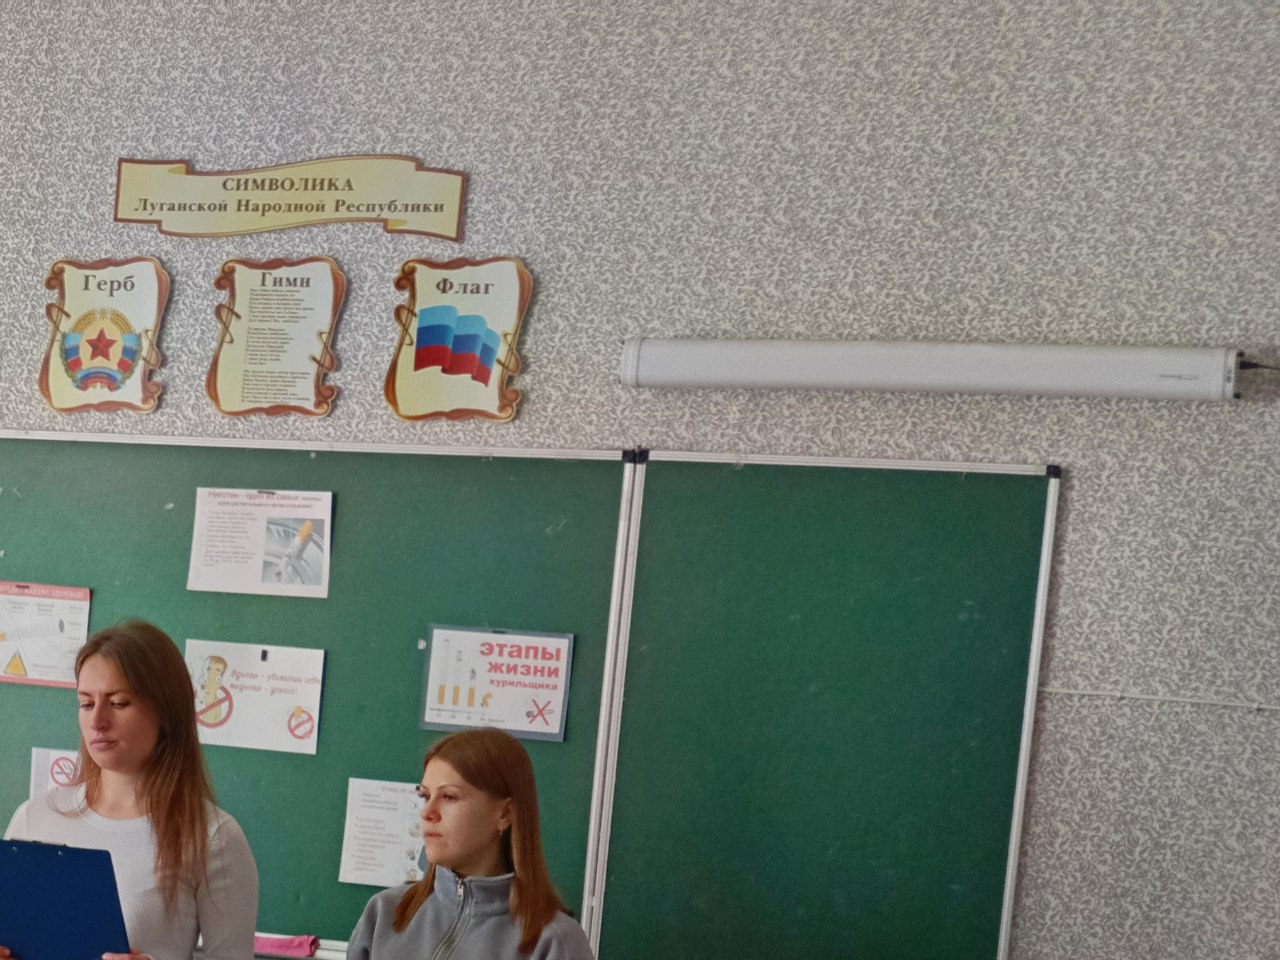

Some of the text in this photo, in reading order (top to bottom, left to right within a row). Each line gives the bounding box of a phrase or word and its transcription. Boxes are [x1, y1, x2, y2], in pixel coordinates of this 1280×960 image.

[222, 177, 354, 192] СИМВОЛИКА
[134, 198, 445, 217] Луганской Народной Республики
[83, 273, 136, 296] Герб
[260, 272, 311, 288] Гимн
[436, 276, 495, 296] Флаг
[489, 679, 558, 691] курильщика
